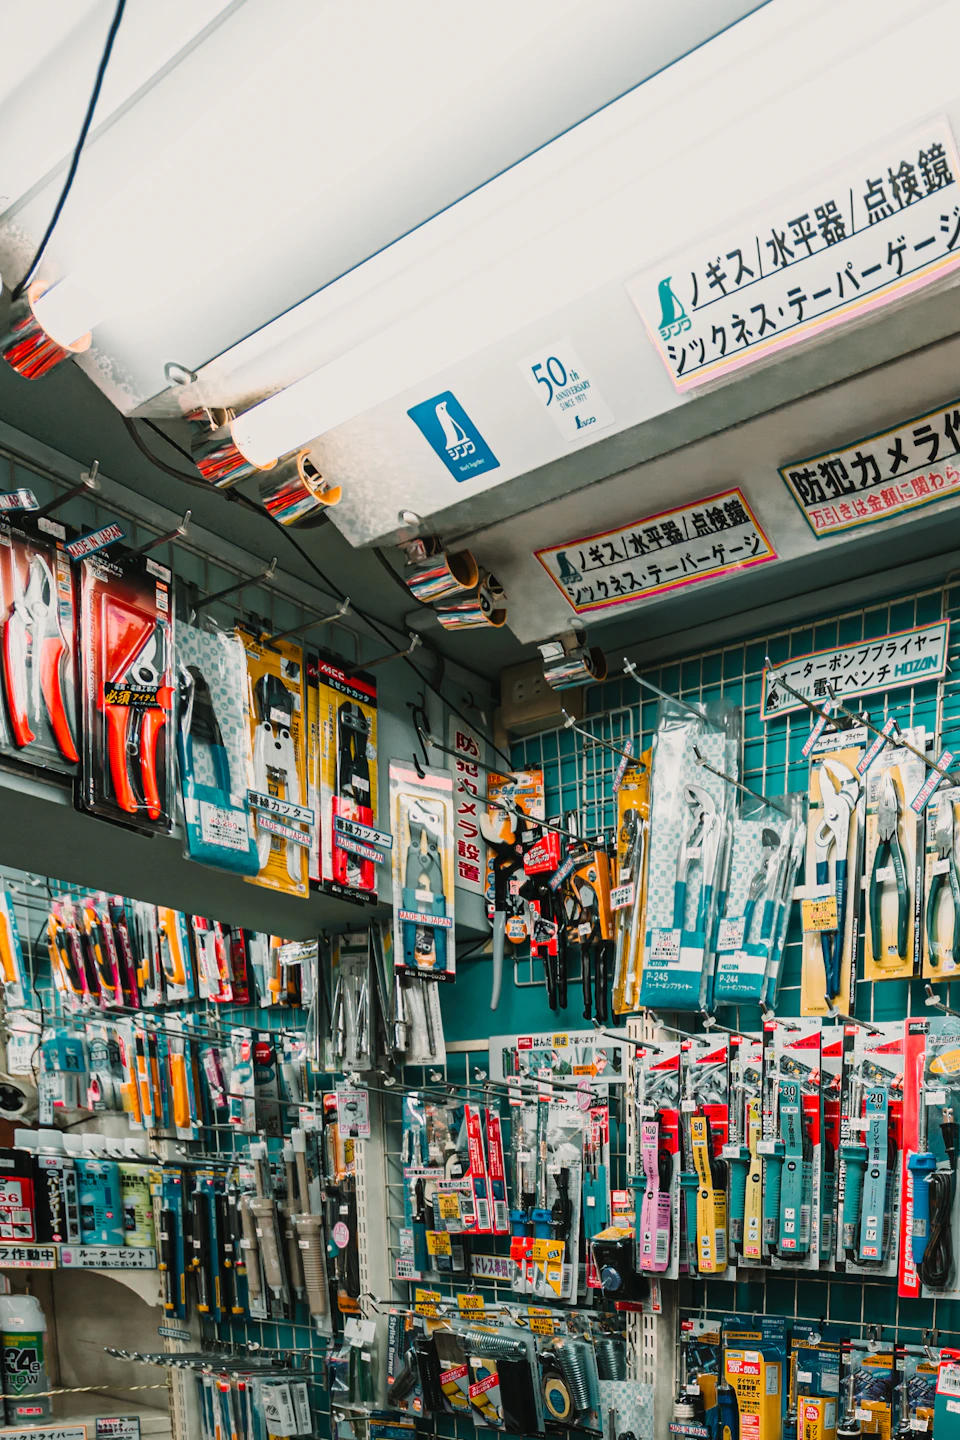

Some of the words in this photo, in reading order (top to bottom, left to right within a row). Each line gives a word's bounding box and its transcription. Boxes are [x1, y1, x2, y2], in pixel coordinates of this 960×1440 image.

[67, 535, 89, 559] MADE
[97, 523, 123, 543] JAPAN
[566, 531, 761, 604] シックネス・テーパーゲージ
[322, 664, 346, 681] MCC
[894, 654, 939, 677] HOZAN
[813, 664, 891, 697] 電工ペンチ
[249, 791, 313, 820] 番線カッター
[335, 818, 392, 847] 番線カッター
[646, 971, 669, 983] P-245
[719, 973, 739, 984] P-244
[782, 1085, 796, 1097] 30
[869, 1093, 883, 1104] 20
